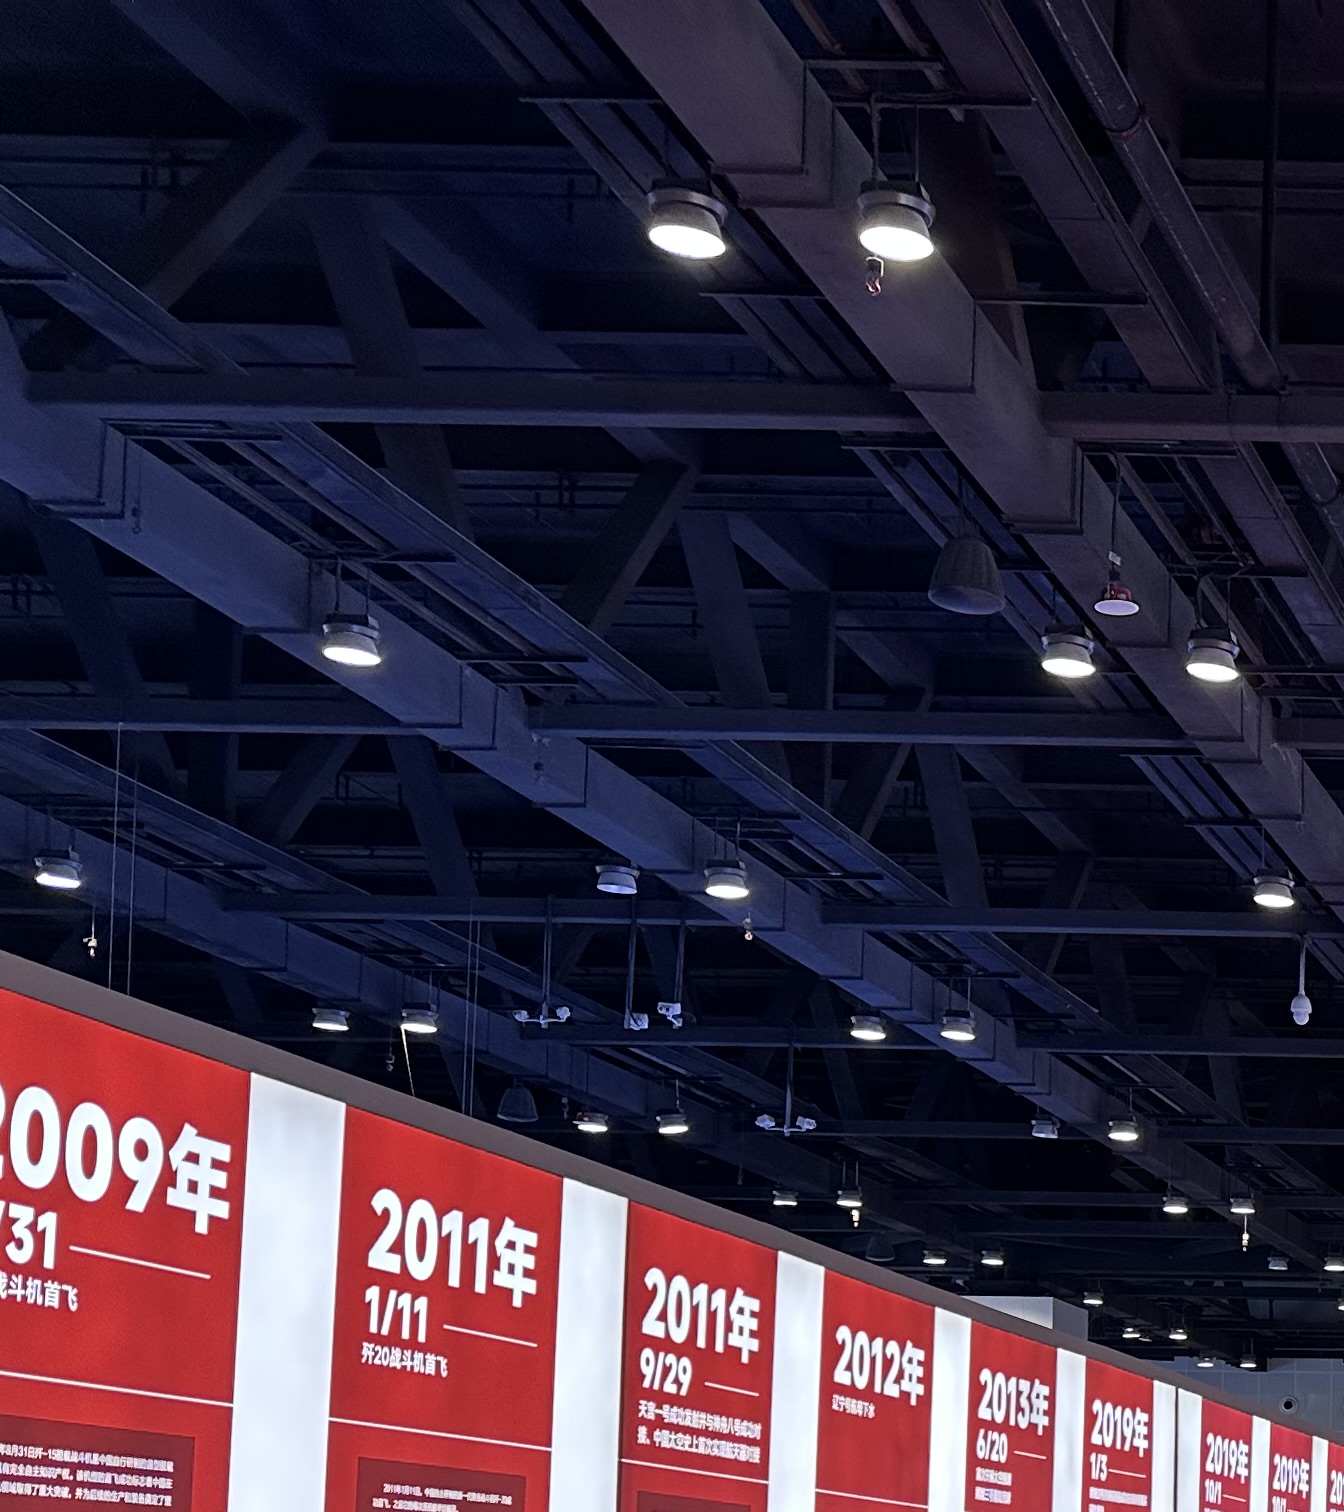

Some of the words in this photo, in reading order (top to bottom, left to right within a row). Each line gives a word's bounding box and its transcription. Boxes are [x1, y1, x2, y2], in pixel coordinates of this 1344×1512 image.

[0, 1084, 231, 1235] 009年
[367, 1188, 538, 1308] 2011年
[365, 1285, 428, 1343] 1/11
[641, 1267, 760, 1364] 2011年
[361, 1342, 448, 1378] 歼20战斗机首飞
[640, 1347, 692, 1396] 9/29
[833, 1325, 925, 1406] 2012年
[977, 1368, 1049, 1436] 2013年
[1091, 1399, 1149, 1457] 2019年
[976, 1429, 1008, 1463] 6/20
[1090, 1452, 1107, 1481] 1/3
[1205, 1432, 1249, 1484] 2019年
[1204, 1479, 1222, 1505] 10/1
[1272, 1454, 1310, 1499] 2019年
